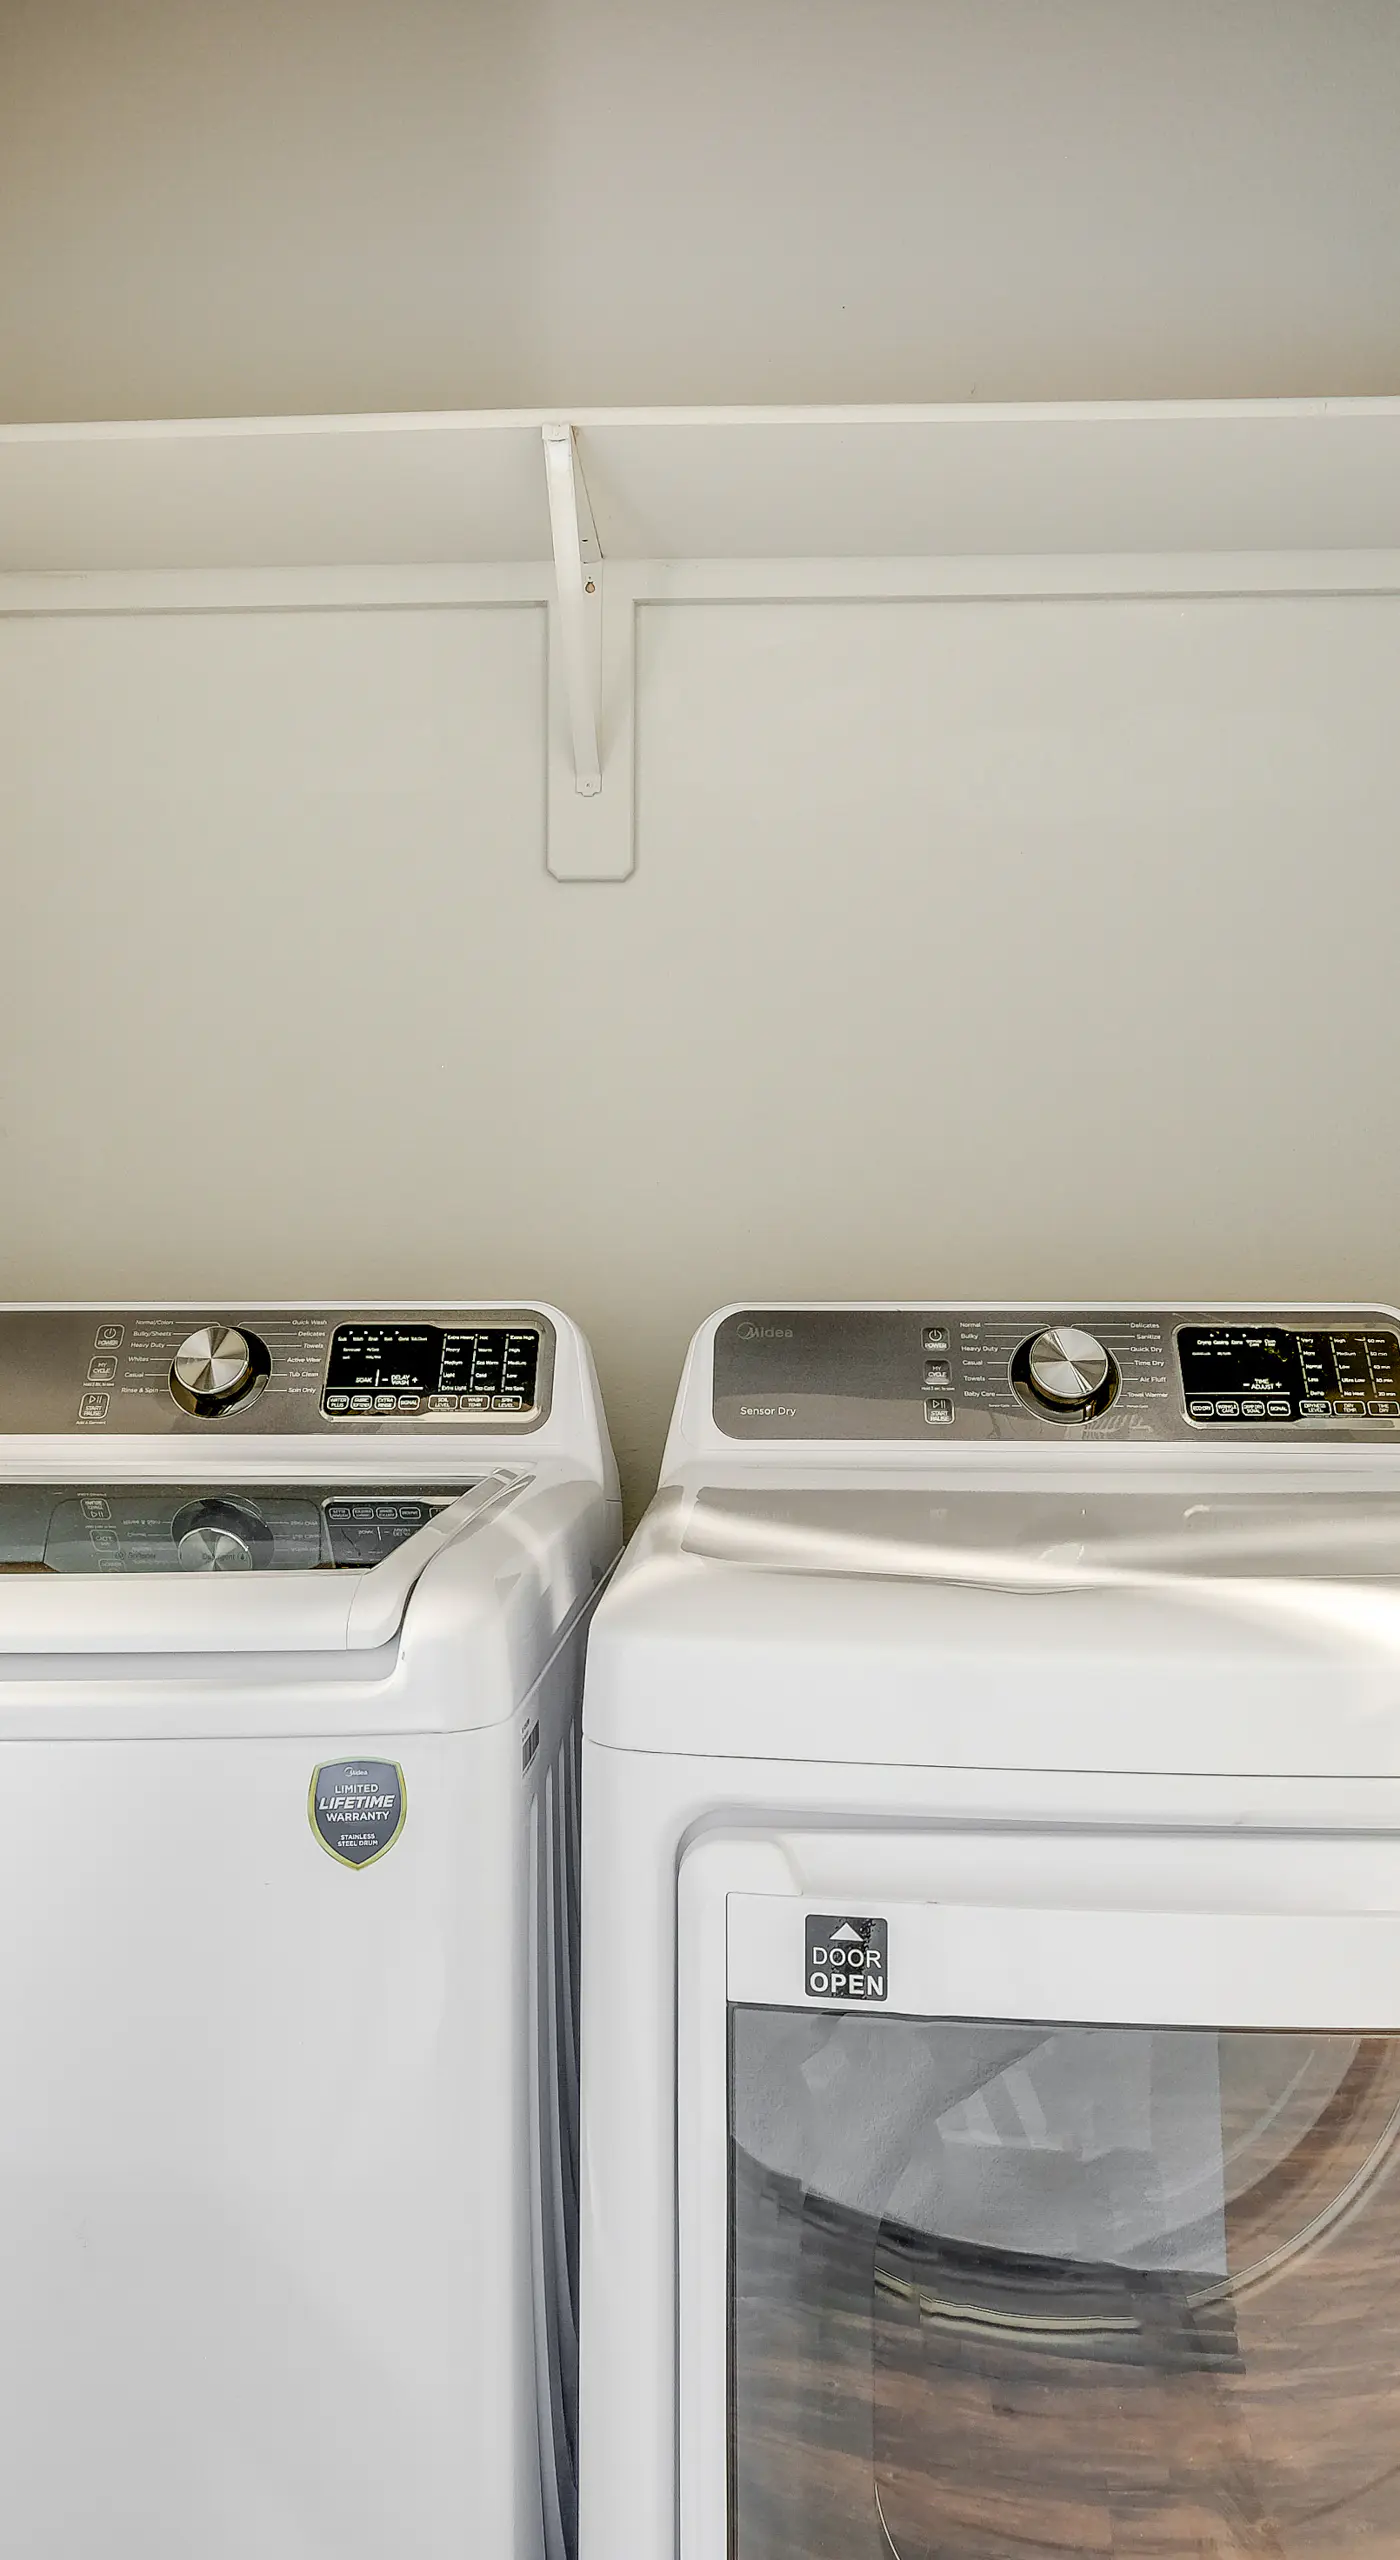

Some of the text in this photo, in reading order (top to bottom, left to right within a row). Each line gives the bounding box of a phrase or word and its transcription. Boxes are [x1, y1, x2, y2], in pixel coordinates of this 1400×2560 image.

[736, 1322, 793, 1340] Midea
[740, 1406, 796, 1416] Sensor Dry
[344, 1767, 368, 1777] Midea
[335, 1784, 378, 1794] LIMITED
[319, 1795, 395, 1810] LIFETIME
[326, 1811, 390, 1822] WARRANTY
[812, 1946, 882, 1969] DOOR
[810, 1972, 883, 1996] OPEN
